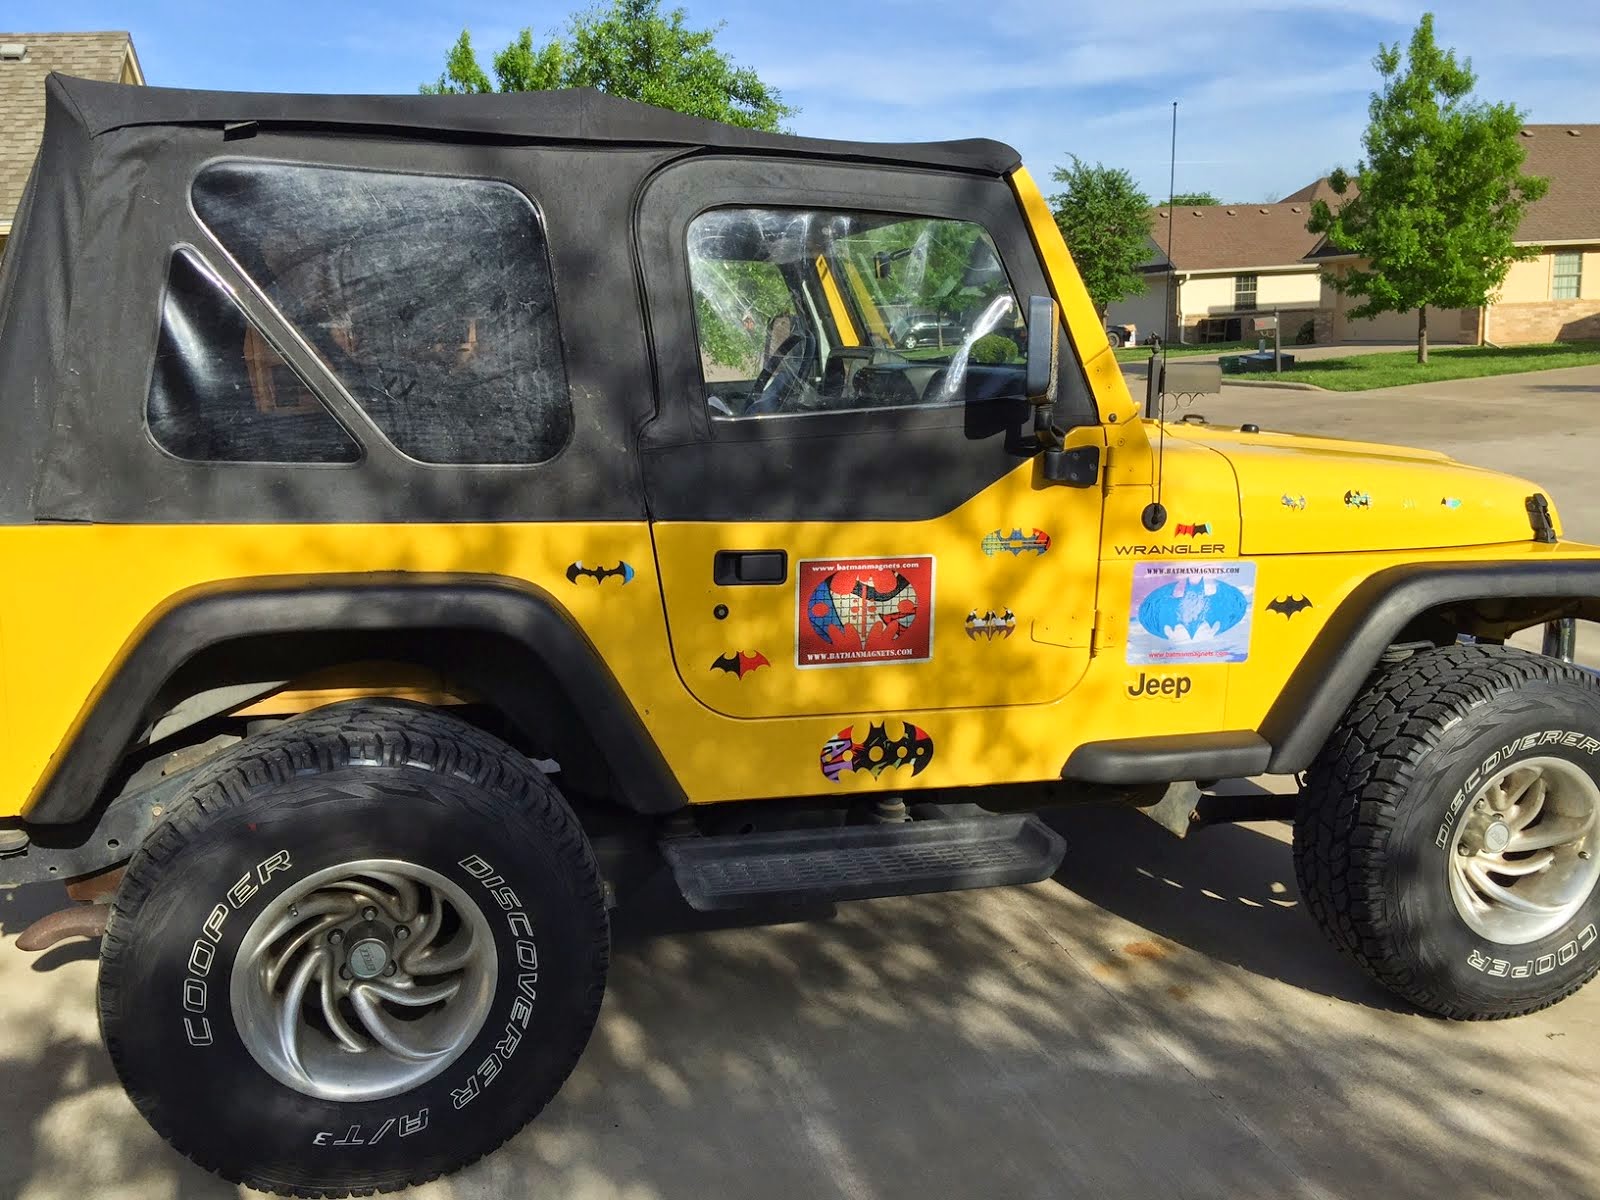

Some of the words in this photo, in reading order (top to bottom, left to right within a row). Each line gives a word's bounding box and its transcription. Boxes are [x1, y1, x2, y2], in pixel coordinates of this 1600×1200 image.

[1114, 545, 1225, 555] WRANGLER
[812, 562, 919, 571] www.batmanmagnets.com
[1147, 567, 1240, 575] WWW.BATMANMAGNETS.COM
[807, 649, 913, 661] WWW.BATMANMAGNETS.COM
[1128, 673, 1191, 698] Jeep
[1435, 730, 1600, 850] DISCOVERER
[1467, 923, 1598, 978] COOPER
[183, 849, 291, 1047] COOPER
[450, 854, 538, 1110] DISCOVERER
